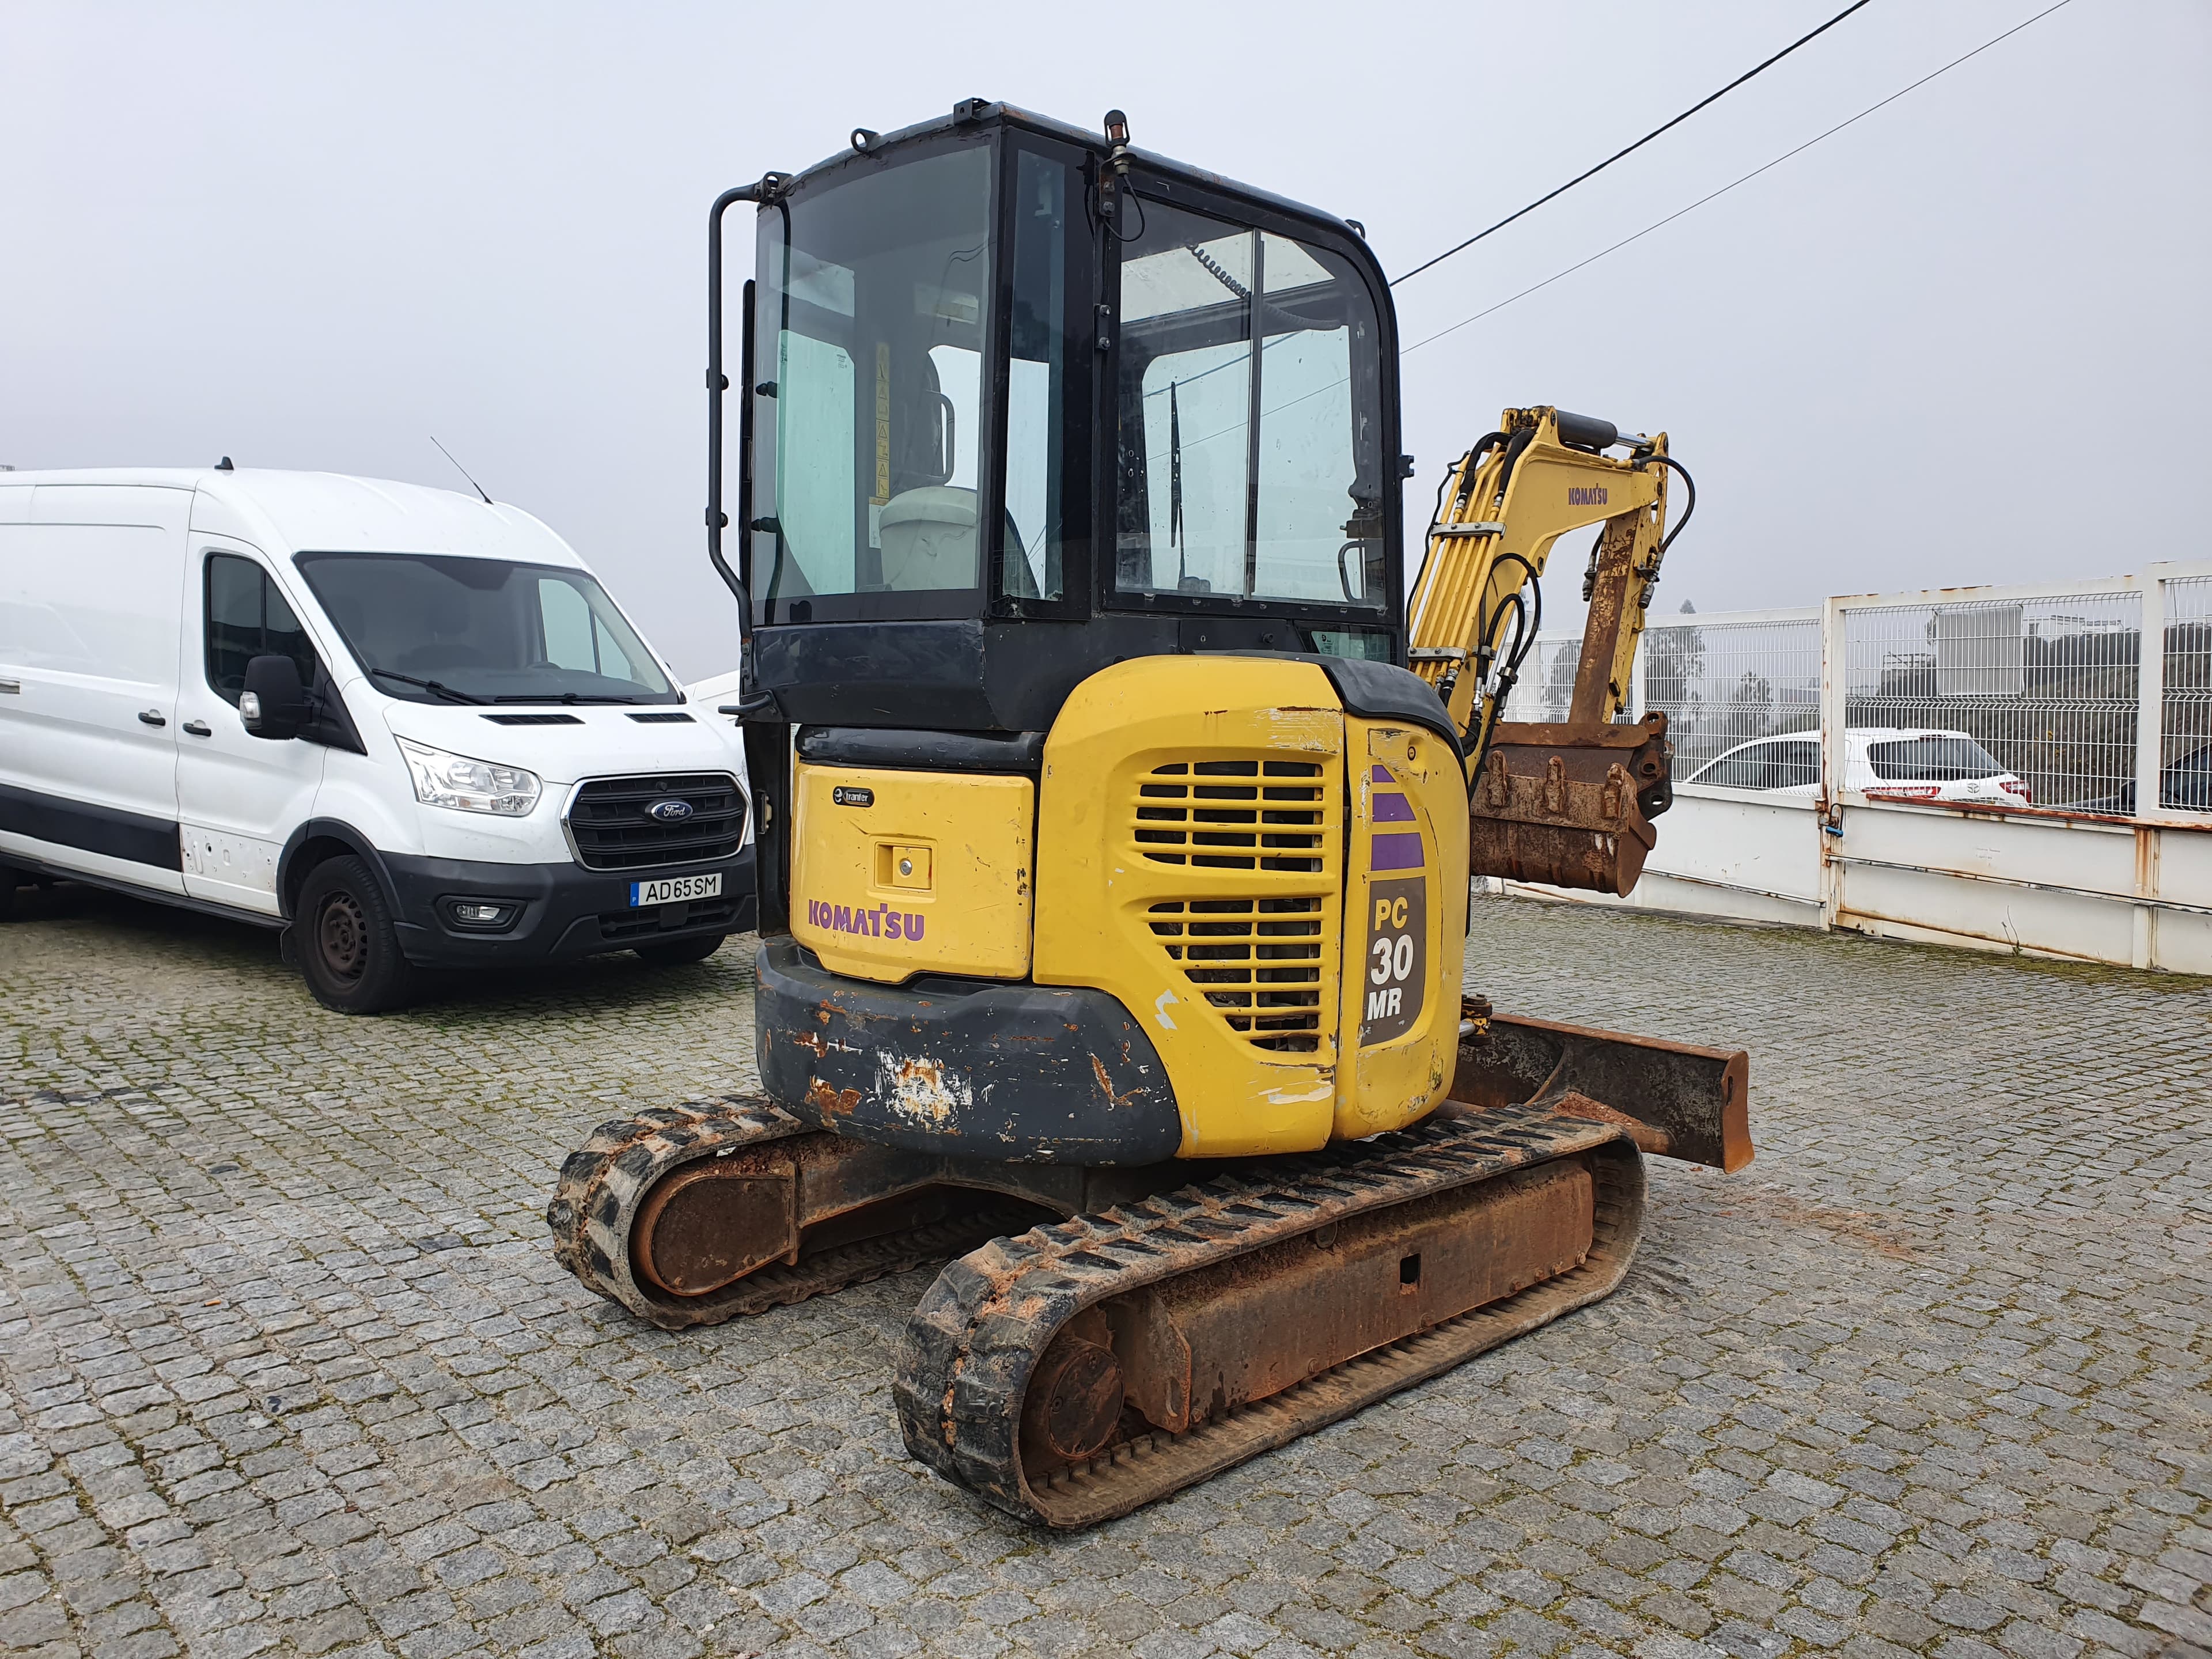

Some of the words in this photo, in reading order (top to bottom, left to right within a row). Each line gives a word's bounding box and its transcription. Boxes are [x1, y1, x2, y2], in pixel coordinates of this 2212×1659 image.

[1568, 482, 1608, 505] KOMATSU
[663, 804, 685, 817] Ford
[808, 899, 925, 941] KOMATSU
[1374, 896, 1408, 931] PC
[1371, 934, 1414, 984] 30
[1367, 987, 1402, 1021] MR
